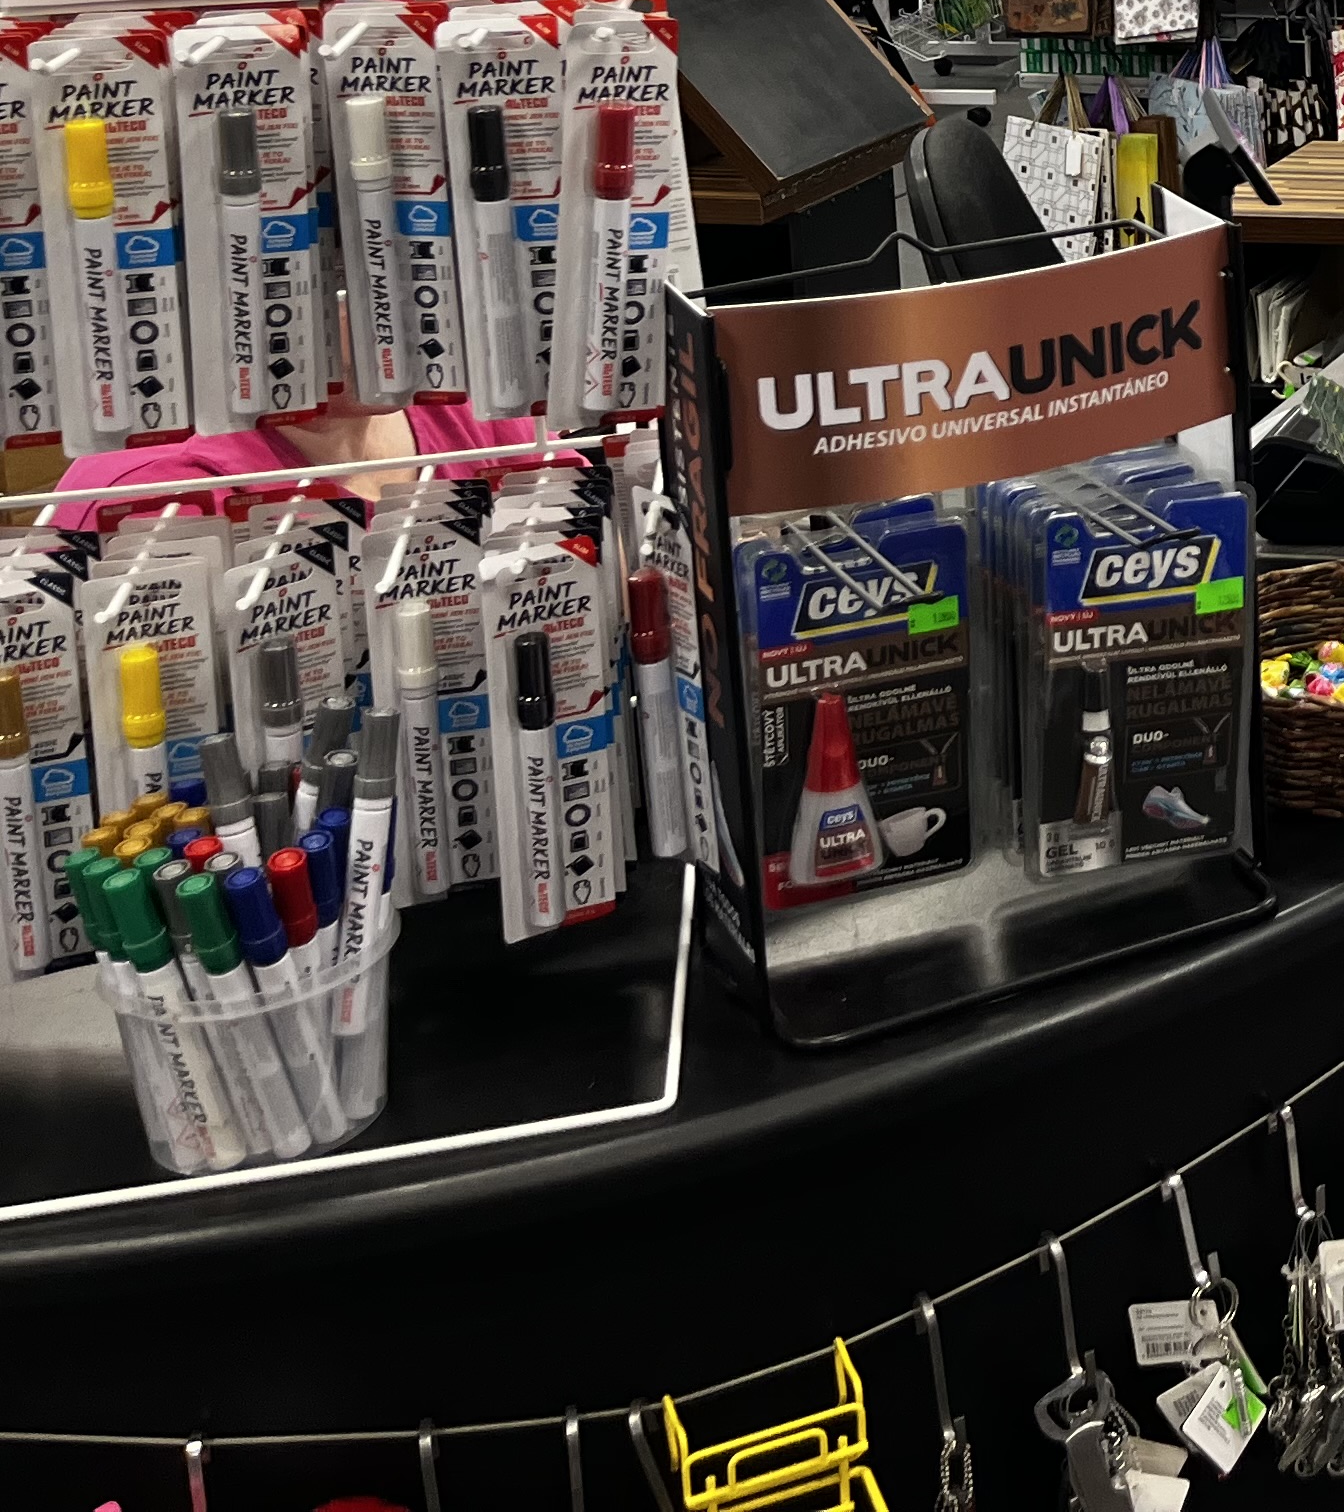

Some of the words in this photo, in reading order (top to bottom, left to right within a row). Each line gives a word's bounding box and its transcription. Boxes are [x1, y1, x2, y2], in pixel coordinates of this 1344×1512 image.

[206, 69, 279, 90] PAINT
[351, 57, 416, 74] PAINT
[468, 60, 538, 79] PAINT
[591, 66, 658, 83] PAINT
[61, 80, 137, 102] PAINT
[193, 87, 295, 110] MARKER
[341, 75, 432, 93] MARKER
[457, 77, 555, 98] MARKER
[578, 83, 669, 103] MARKER
[49, 98, 154, 123] MARKER
[231, 233, 249, 290] PAINT
[365, 219, 386, 271] PAINT
[604, 228, 623, 283] PAINT
[84, 247, 106, 304] PAINT
[369, 274, 394, 346] MARKER
[600, 286, 621, 361] MARKER
[91, 306, 114, 381] MARKER
[233, 291, 253, 364] MARKER
[757, 299, 1203, 431] ULTRAUNICK
[813, 425, 927, 455] ADHESIVO
[932, 404, 1044, 441] UNIVERSAL
[1047, 371, 1169, 417] INSTANTÁNEO
[397, 559, 460, 581] PAINT
[1094, 544, 1202, 589] ceys
[379, 574, 476, 601] MARKER
[509, 581, 577, 609] PAINT
[807, 571, 920, 619] ceys
[117, 603, 180, 626] PAINT
[251, 590, 317, 623] PAINT
[498, 598, 591, 631] MARKER
[106, 617, 194, 645] MARKER
[240, 604, 330, 645] MARKER
[413, 727, 433, 775] PAINT
[527, 756, 546, 806] PAINT
[417, 781, 438, 849] MARKER
[826, 809, 855, 826] ceys
[531, 812, 551, 880] MARKER
[819, 829, 866, 849] ULTRA
[1045, 845, 1078, 860] GEL
[353, 839, 373, 897] PAINT
